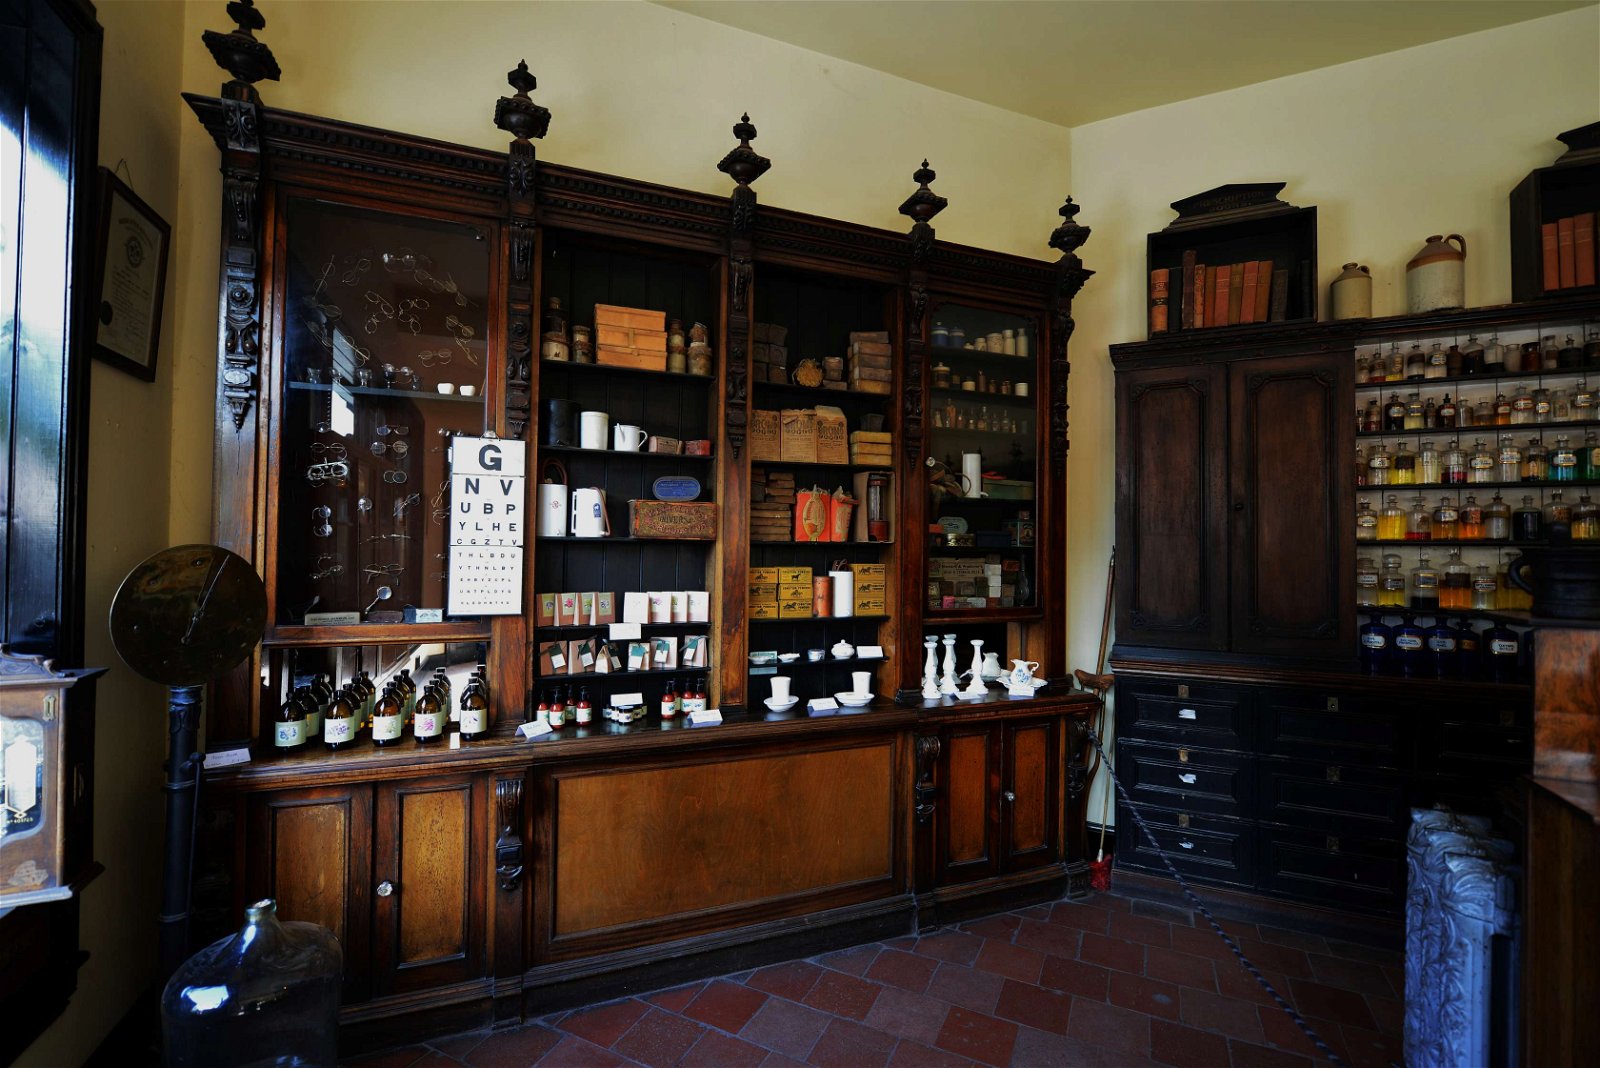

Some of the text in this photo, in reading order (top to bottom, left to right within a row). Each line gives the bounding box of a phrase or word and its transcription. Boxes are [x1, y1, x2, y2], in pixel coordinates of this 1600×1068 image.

[478, 443, 502, 472] G
[464, 477, 514, 496] N V
[460, 501, 516, 516] U B P
